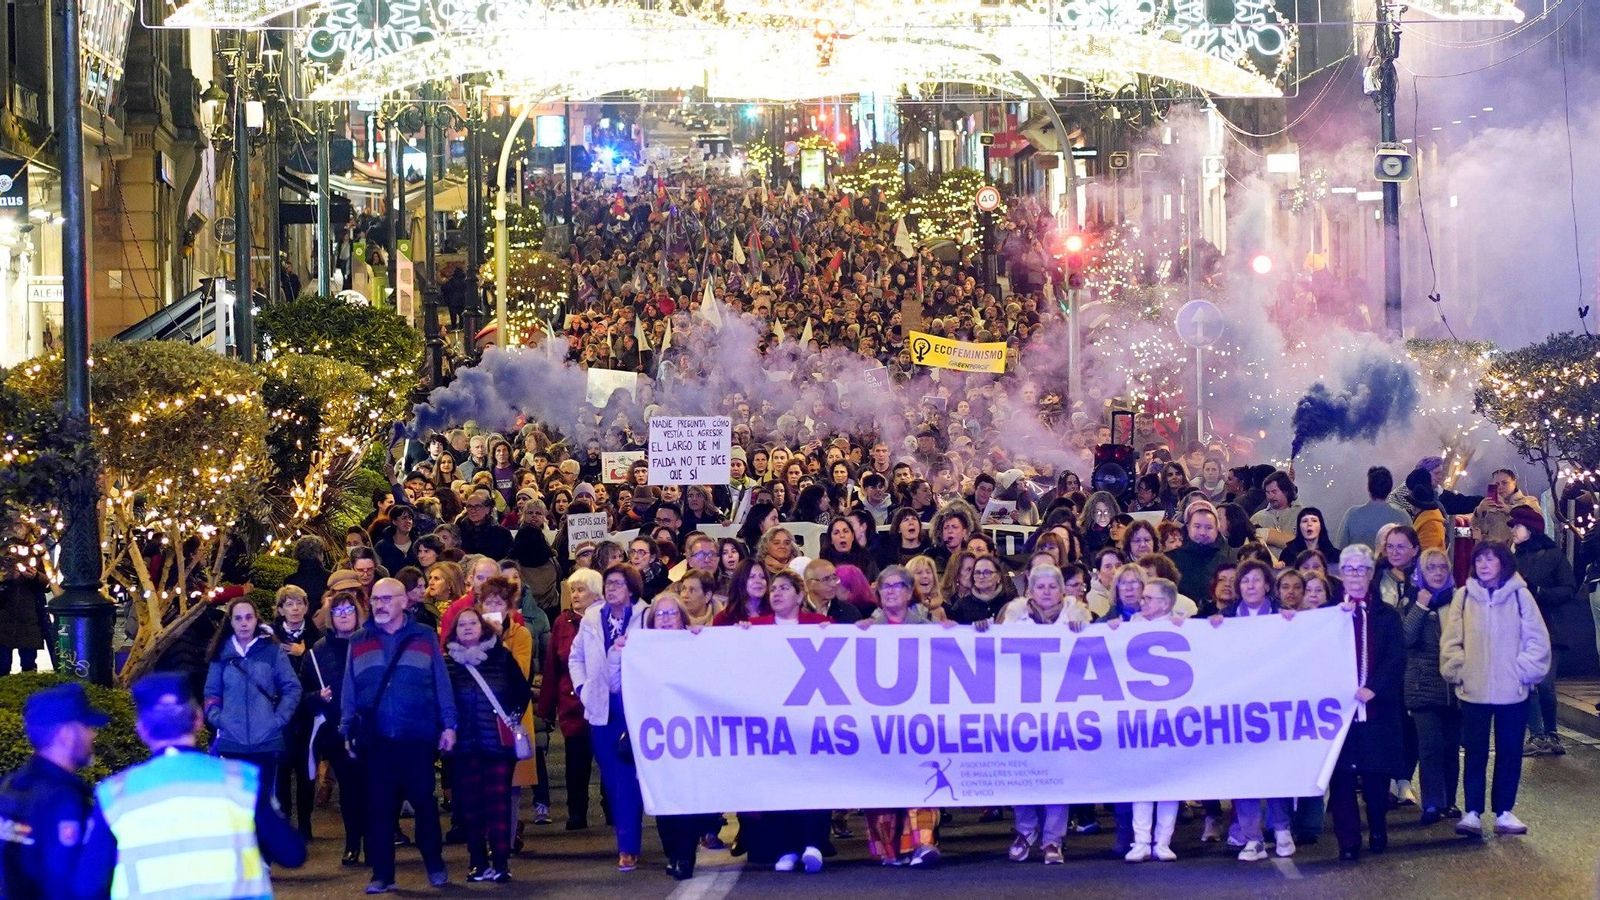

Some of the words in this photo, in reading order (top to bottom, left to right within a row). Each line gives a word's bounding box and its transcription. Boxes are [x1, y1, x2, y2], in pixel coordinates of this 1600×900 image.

[934, 344, 1003, 360] ECOFEMINISMO
[677, 419, 706, 428] PREGUNTA
[687, 429, 694, 437] EL
[697, 429, 724, 437] AGRESOR
[651, 442, 662, 452] EL
[667, 441, 693, 451] LARGO
[698, 441, 707, 451] DE
[652, 457, 677, 468] FALDA
[681, 456, 692, 466] NO
[696, 456, 706, 466] TE
[670, 470, 682, 480] QUE
[783, 631, 1194, 706] XUNTAS
[639, 716, 797, 760] CONTRA
[810, 714, 860, 756] AS
[871, 711, 1102, 754] VIOLENCIAS
[1117, 698, 1344, 749] MACHISTAS
[1008, 760, 1028, 768] REDE
[962, 789, 973, 797] DE
